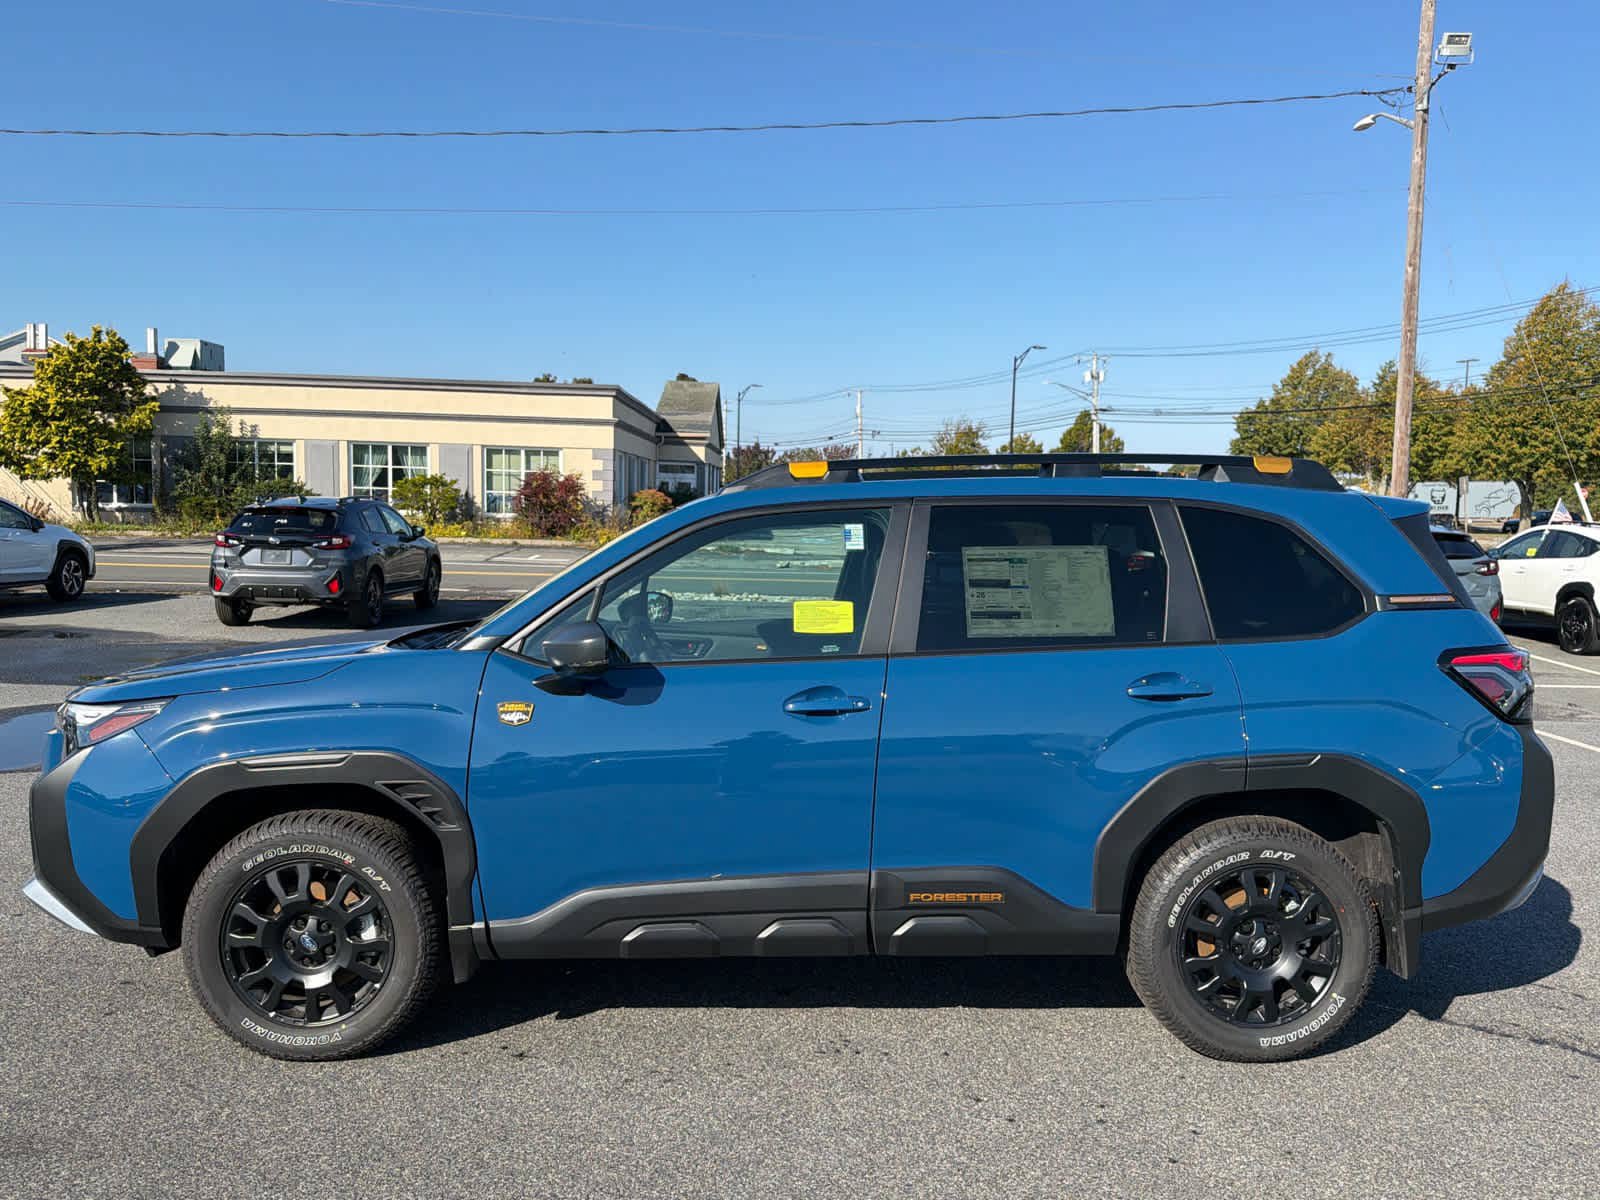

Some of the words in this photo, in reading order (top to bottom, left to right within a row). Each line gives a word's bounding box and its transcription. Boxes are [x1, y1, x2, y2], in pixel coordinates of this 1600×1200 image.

[242, 844, 356, 872] GEOLANDAR
[361, 866, 392, 892] A/T
[1167, 851, 1251, 928] GEOLANDAR
[1259, 849, 1296, 861] A/T
[909, 892, 1004, 902] FORESTER
[240, 1017, 342, 1046] YOKOHAMA
[1259, 995, 1346, 1047] YOKOHAMA
